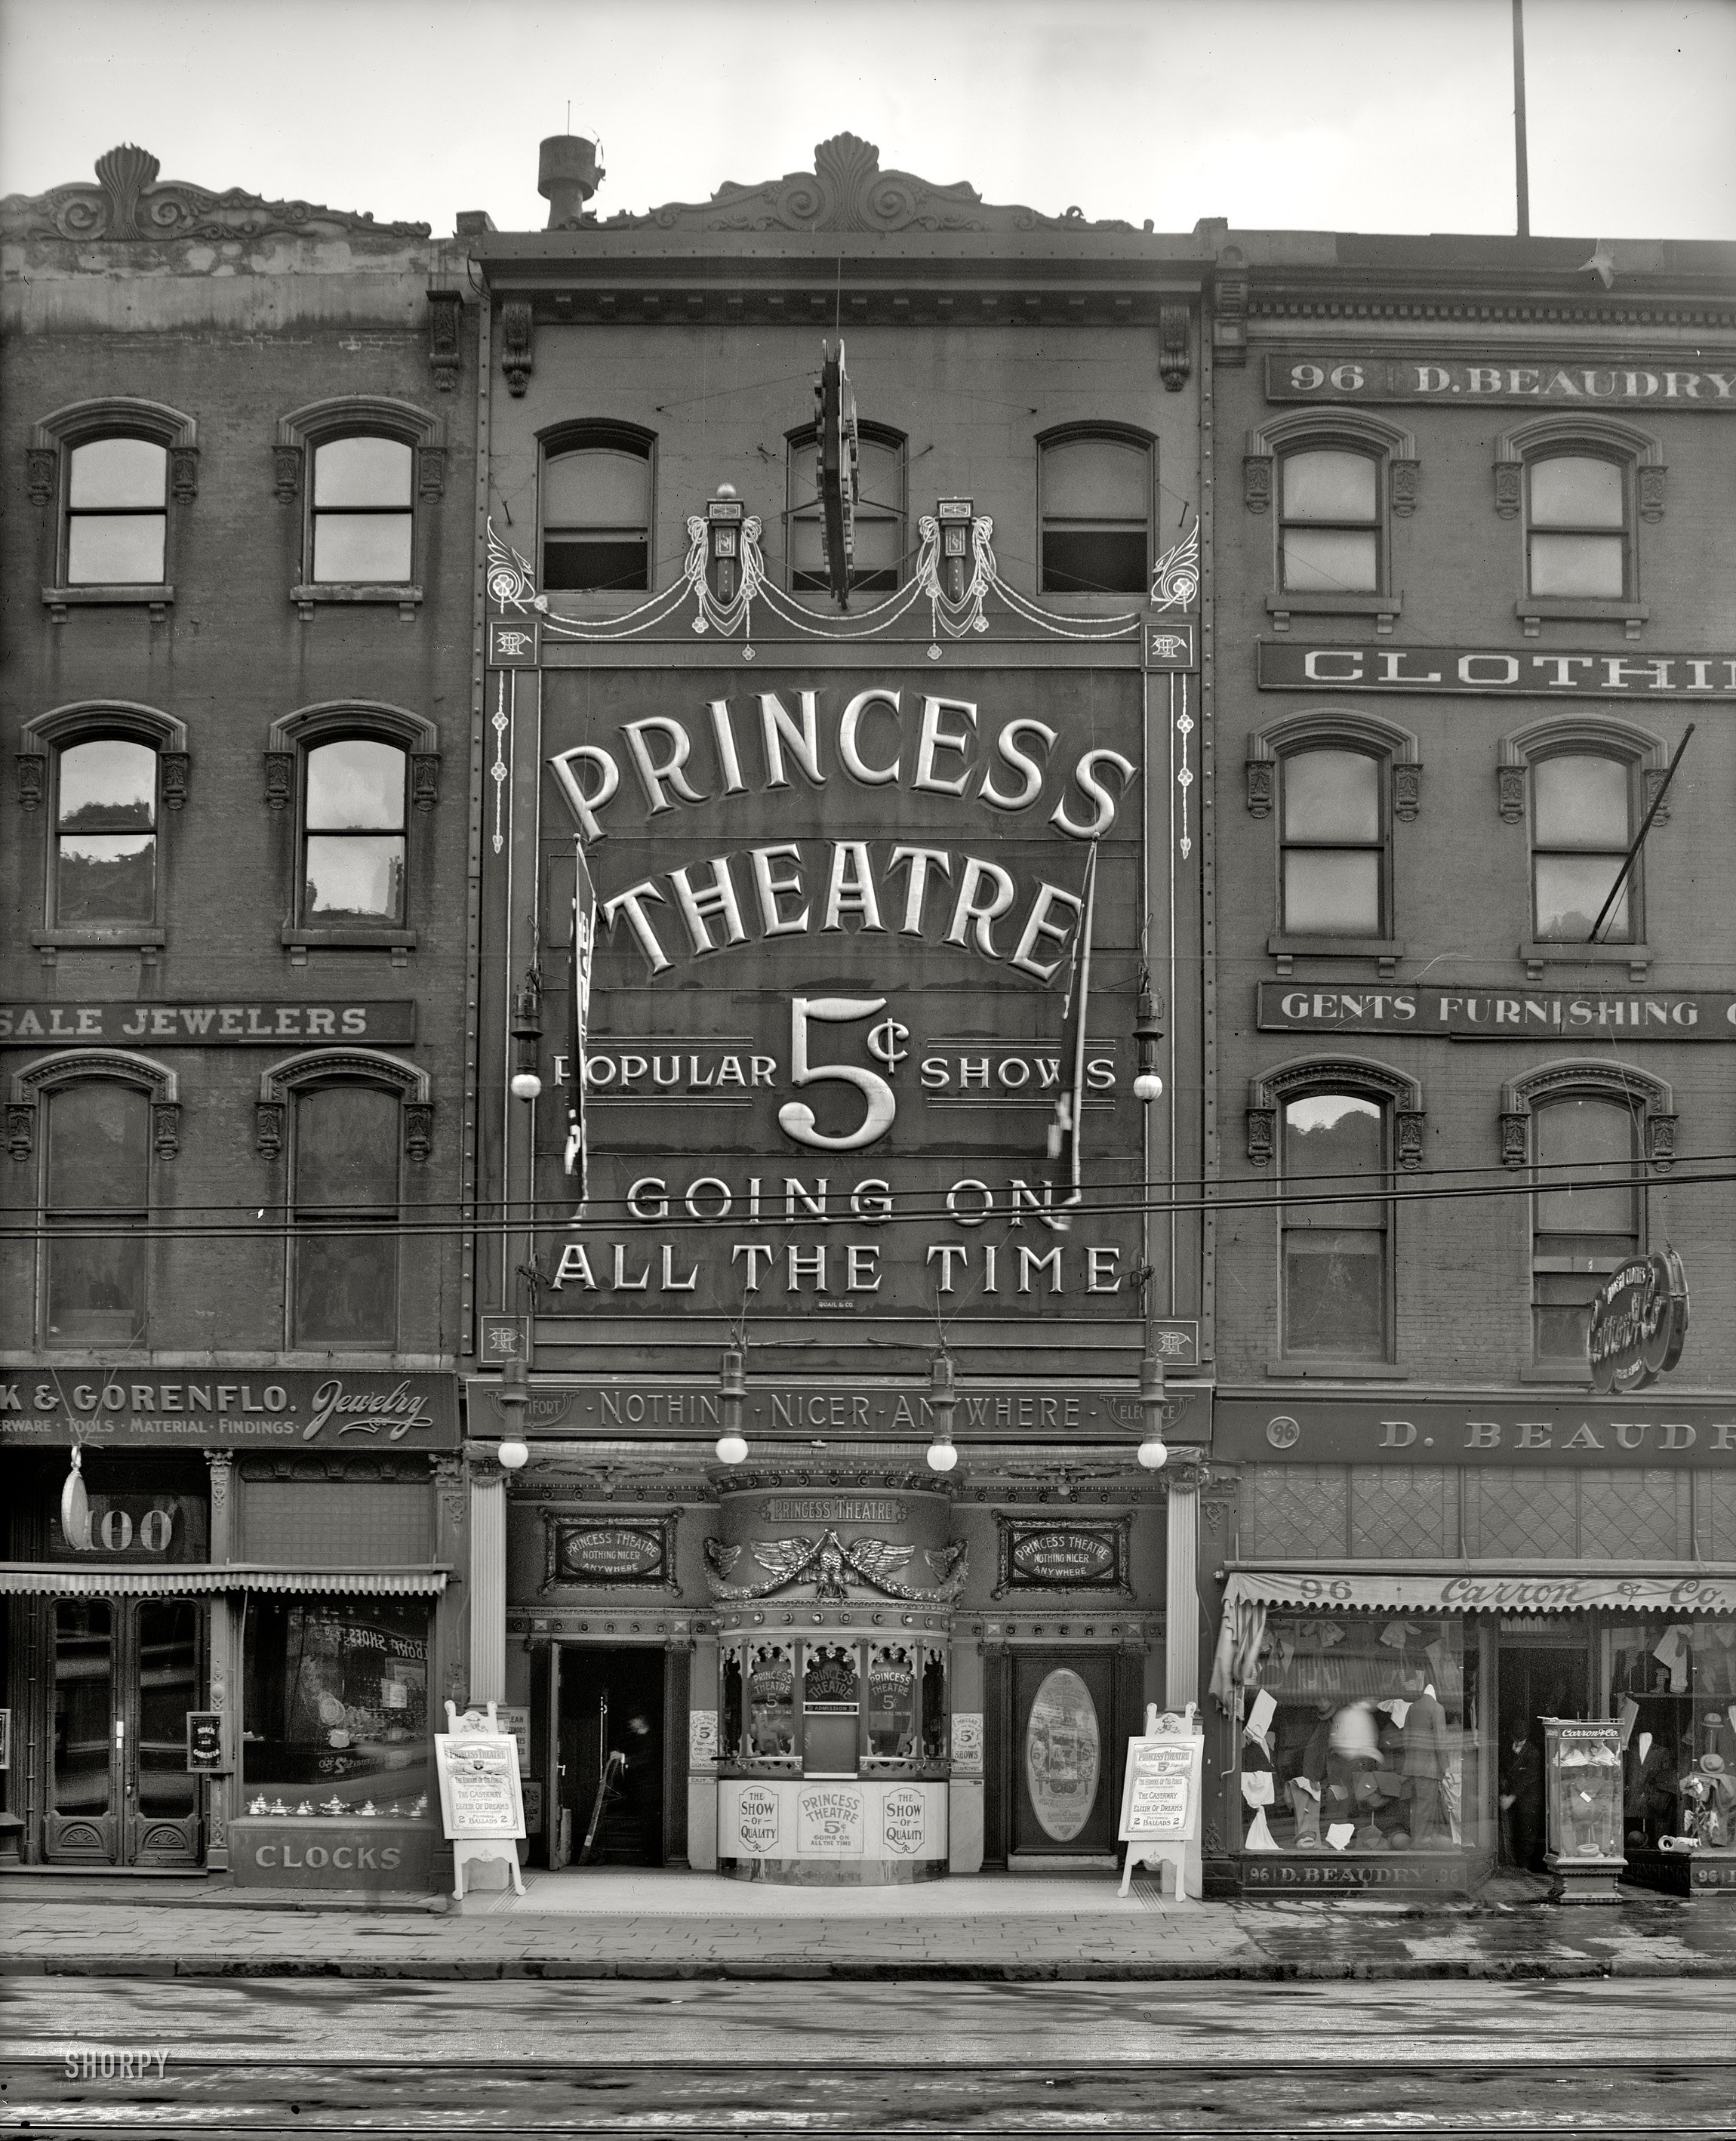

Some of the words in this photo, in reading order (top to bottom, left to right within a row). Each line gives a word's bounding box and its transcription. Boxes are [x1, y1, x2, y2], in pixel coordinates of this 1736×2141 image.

[1290, 364, 1365, 391] 96
[546, 688, 1139, 843] PRINCESS
[604, 841, 1085, 981] THEATRE
[1281, 992, 1416, 1019] GENTS
[1439, 997, 1698, 1027] FURNISHING
[0, 1009, 102, 1037] SALE
[123, 1009, 368, 1036] JEWELERS
[552, 1055, 778, 1089] POPULAR
[920, 1056, 1117, 1090] SHOWS
[626, 1177, 894, 1225] GOING
[946, 1178, 1063, 1229] ON
[549, 1244, 697, 1293] ALL
[731, 1244, 883, 1293] THE
[925, 1245, 1122, 1295] TIME
[34, 1385, 60, 1410] &
[73, 1385, 297, 1411] GORENFLO.
[302, 1379, 433, 1441] Jewelry
[599, 1391, 721, 1426] NOTHIN
[770, 1393, 870, 1428] NICER
[890, 1394, 1080, 1428] ANWHERE
[1119, 1405, 1175, 1419] ELECE
[66, 1417, 114, 1433] TOOLS
[130, 1417, 208, 1433] MATERIAL
[219, 1418, 294, 1434] FINDINGS
[1273, 1421, 1296, 1444] 96
[1380, 1421, 1434, 1449] D.
[774, 1500, 831, 1520] PRINCESS
[835, 1499, 893, 1520] THEATRE
[567, 1533, 612, 1557] PRINCESS
[615, 1533, 659, 1557] THEATRE
[1015, 1536, 1065, 1560] PRINCESS
[1069, 1536, 1110, 1560] THEATRE
[582, 1550, 617, 1560] NOTHING
[617, 1550, 640, 1560] NICER
[1034, 1553, 1064, 1563] NOTHING
[1066, 1553, 1089, 1563] NICER
[582, 1562, 639, 1573] ANYWHERE
[1033, 1565, 1087, 1577] ANYWHERE
[1300, 1579, 1353, 1600] 96
[1440, 1576, 1582, 1605] Carron
[1669, 1579, 1727, 1606] Co.
[753, 1670, 792, 1684] PRINCESS
[808, 1668, 856, 1686] PRINCESS
[870, 1671, 911, 1686] PRINCESS
[754, 1681, 791, 1695] THEATRE
[808, 1680, 854, 1699] THEATRE
[870, 1683, 910, 1696] THEATRE
[1562, 1728, 1599, 1737] Carron
[954, 1750, 979, 1760] SHOWS
[749, 1792, 764, 1801] THE
[802, 1794, 860, 1811] PRINCESS
[897, 1794, 913, 1802] THE
[1138, 1791, 1149, 1800] THE
[740, 1801, 775, 1815] SHOW
[805, 1807, 859, 1825] THEATRE
[886, 1803, 922, 1817] SHOW
[1152, 1804, 1159, 1813] OF
[1160, 1804, 1183, 1813] DREAMS
[458, 1815, 465, 1823] 2
[500, 1815, 507, 1823] 2
[1133, 1817, 1140, 1825] 2
[1173, 1817, 1180, 1825] 2
[740, 1825, 777, 1844] QUALITY
[886, 1827, 923, 1846] QUALITY
[254, 1844, 402, 1869] CLOCKS
[1248, 1868, 1270, 1881] 96
[1439, 1868, 1460, 1882] 96
[1698, 1869, 1718, 1883] 96
